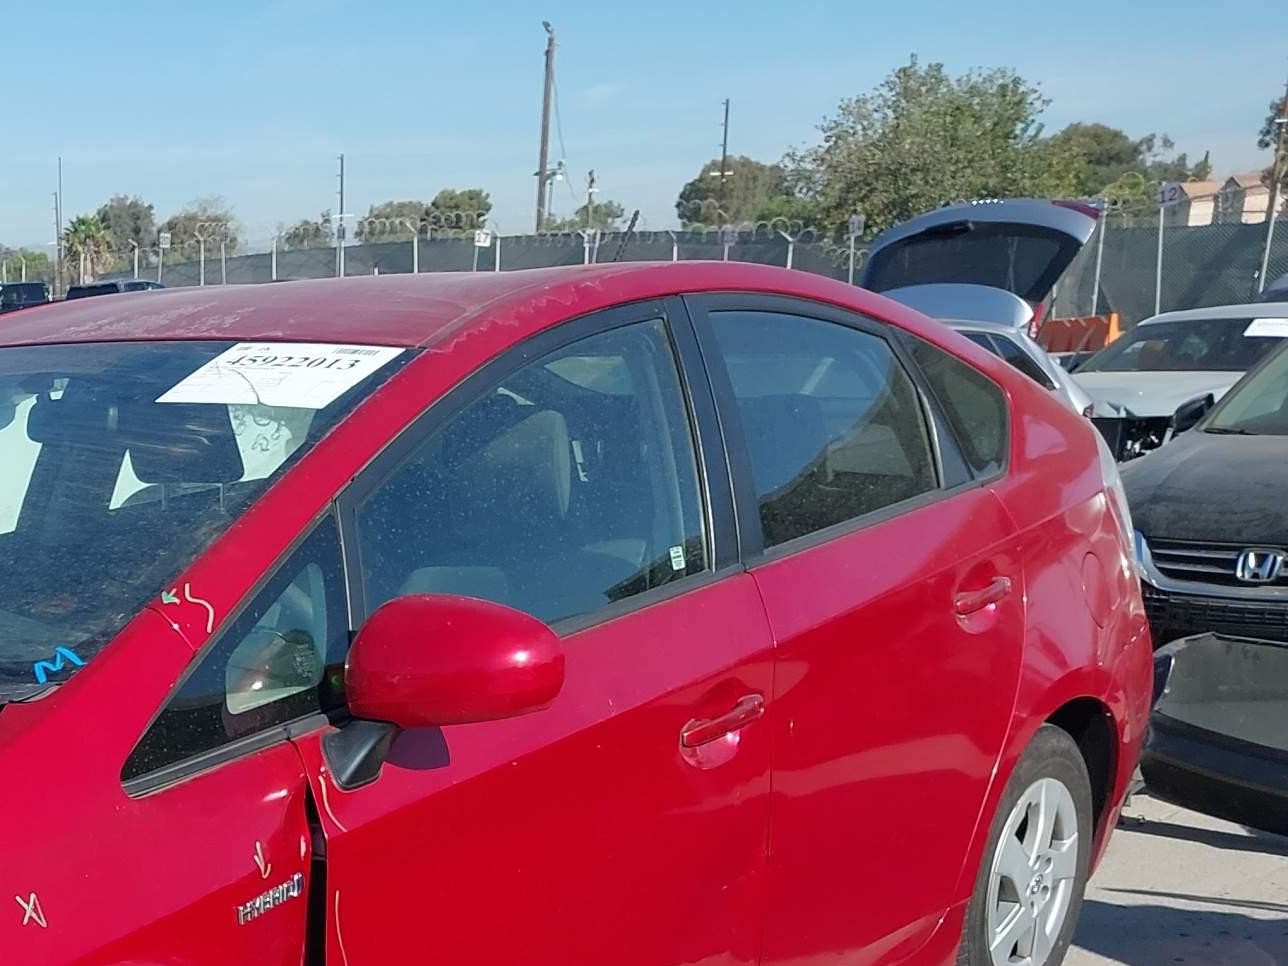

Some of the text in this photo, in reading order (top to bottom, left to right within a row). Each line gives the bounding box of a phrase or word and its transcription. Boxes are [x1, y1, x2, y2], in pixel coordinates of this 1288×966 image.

[1159, 187, 1177, 204] 12
[225, 353, 361, 371] 45922013
[237, 872, 305, 926] HYBRID
